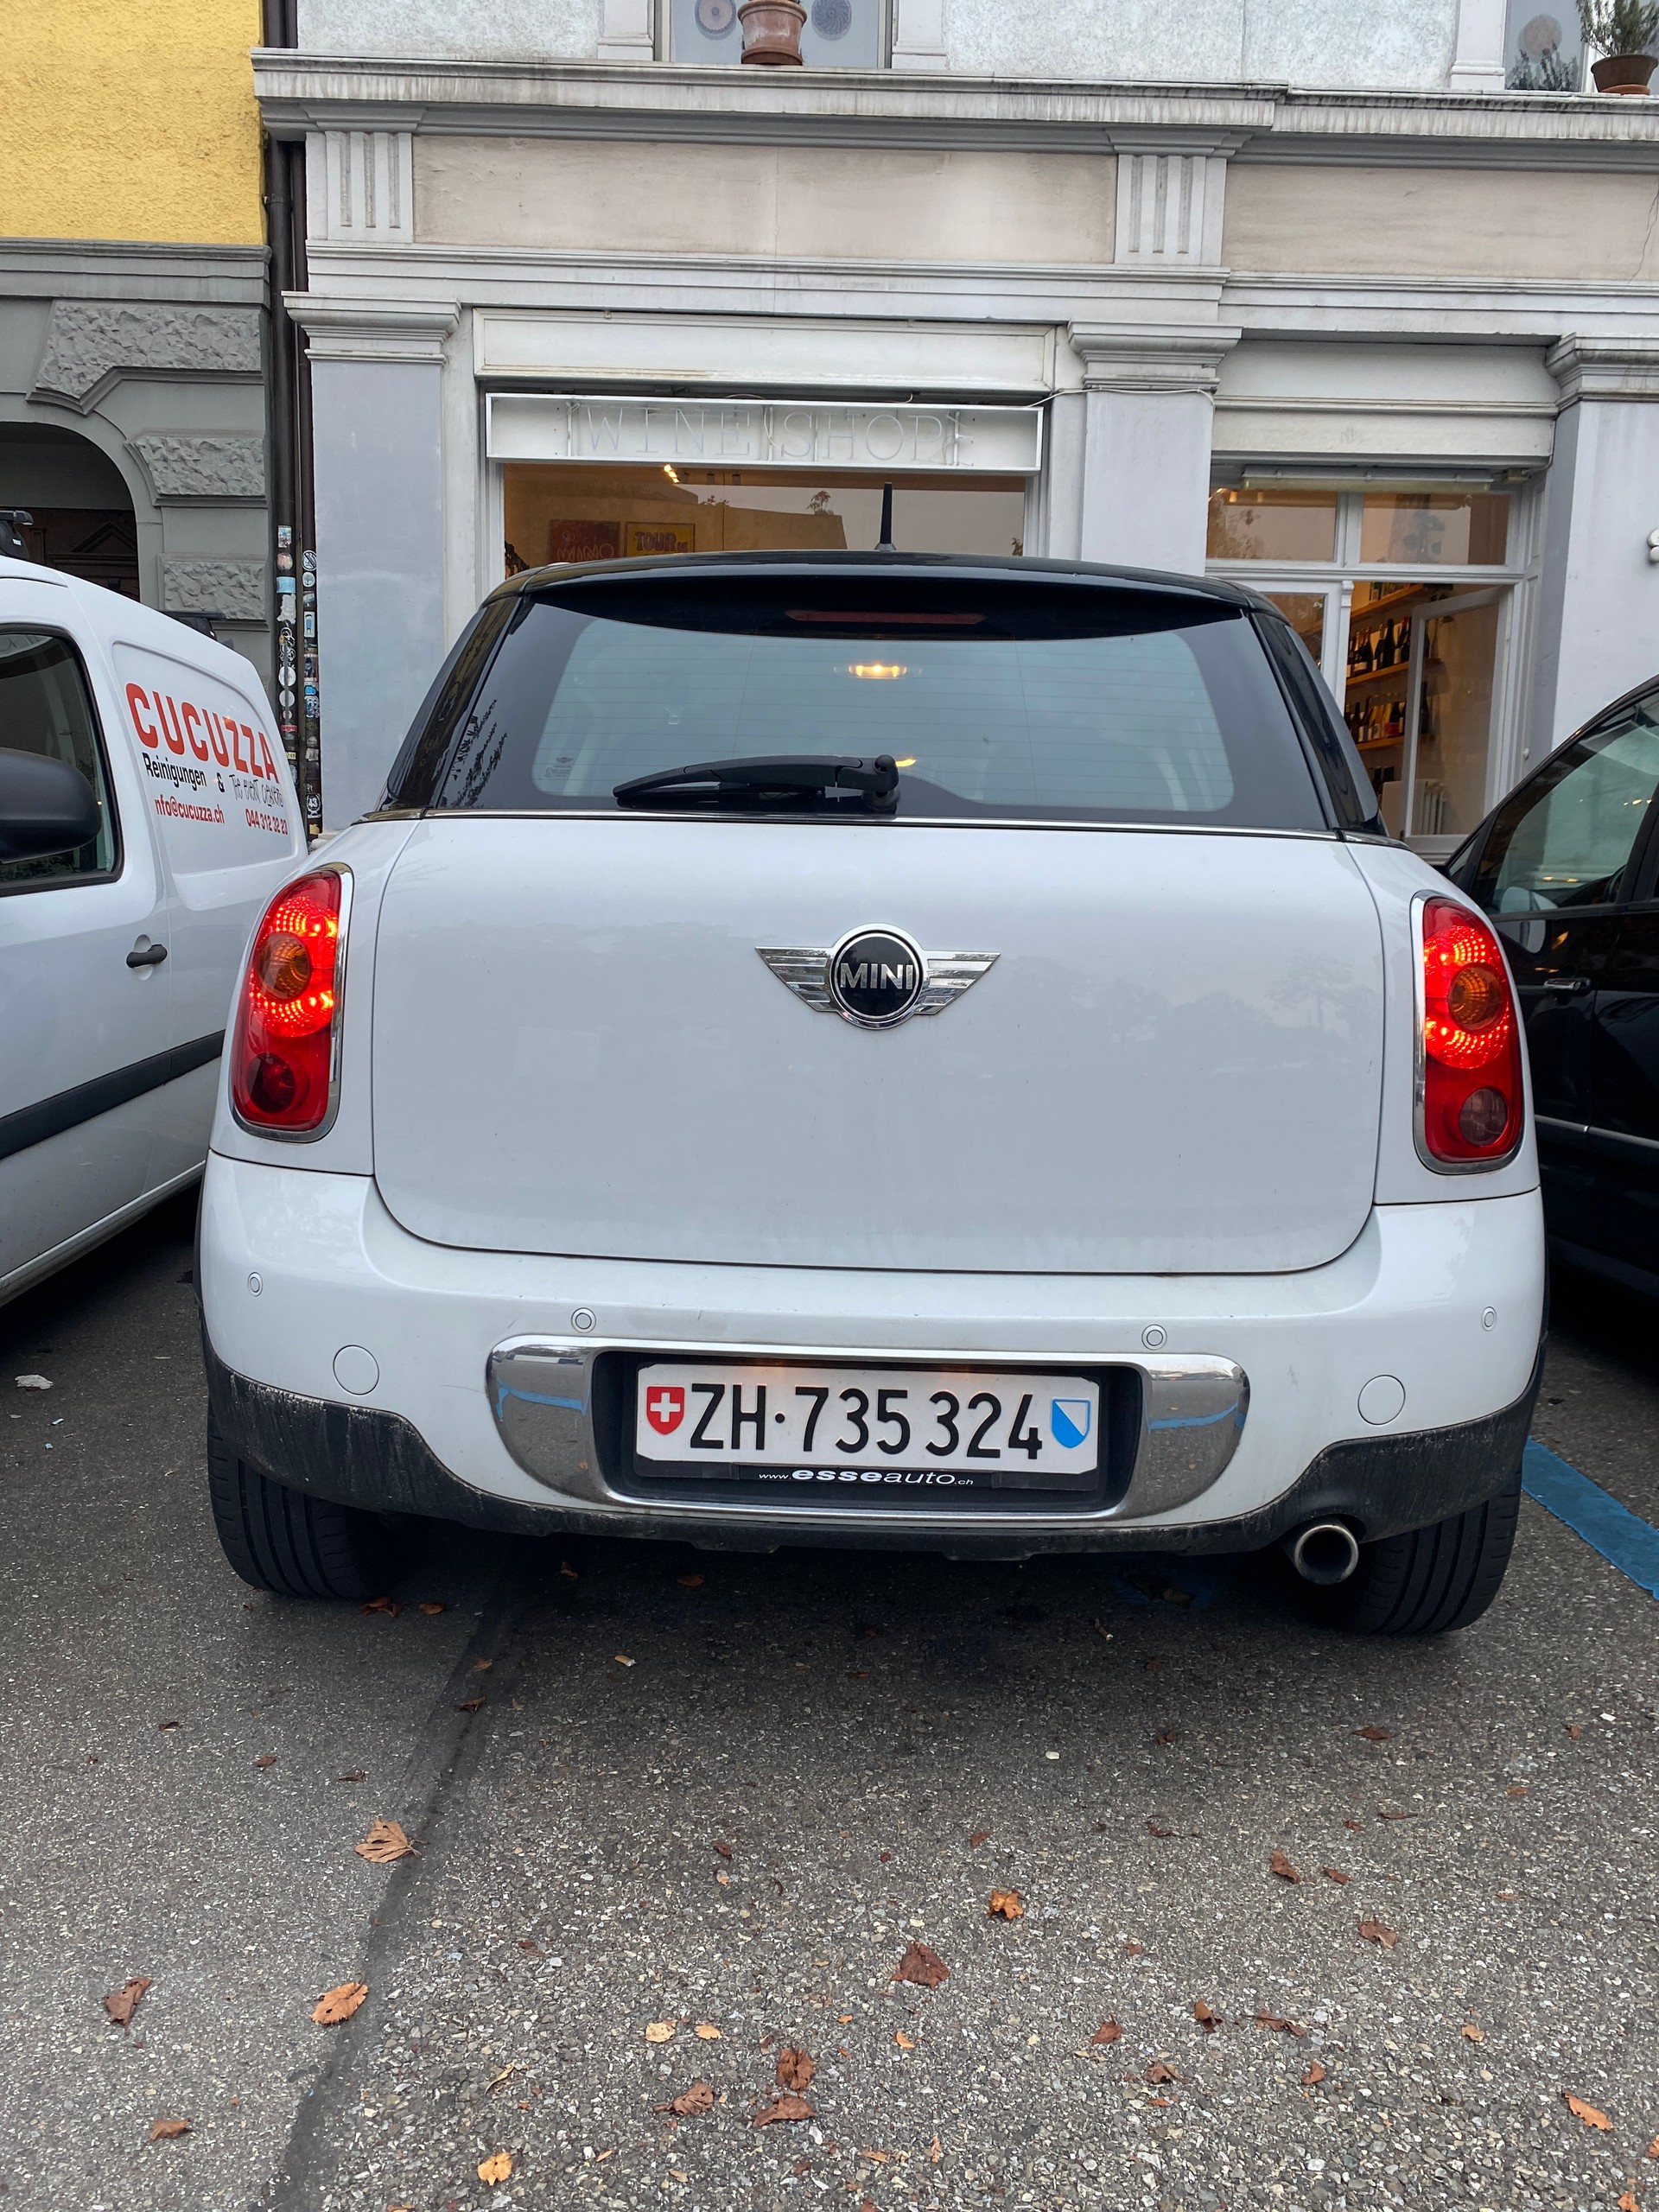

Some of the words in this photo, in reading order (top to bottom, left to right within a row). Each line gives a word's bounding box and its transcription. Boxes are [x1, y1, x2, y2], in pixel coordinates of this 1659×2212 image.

[580, 404, 750, 456] WINE
[780, 411, 943, 461] SHOP
[634, 531, 677, 551] TOUR
[125, 683, 280, 784] CUCUZZA
[142, 752, 207, 791] Reinigungen
[216, 772, 226, 793] &
[840, 963, 913, 990] MINI
[759, 1469, 974, 1485] www.esseauto.ch
